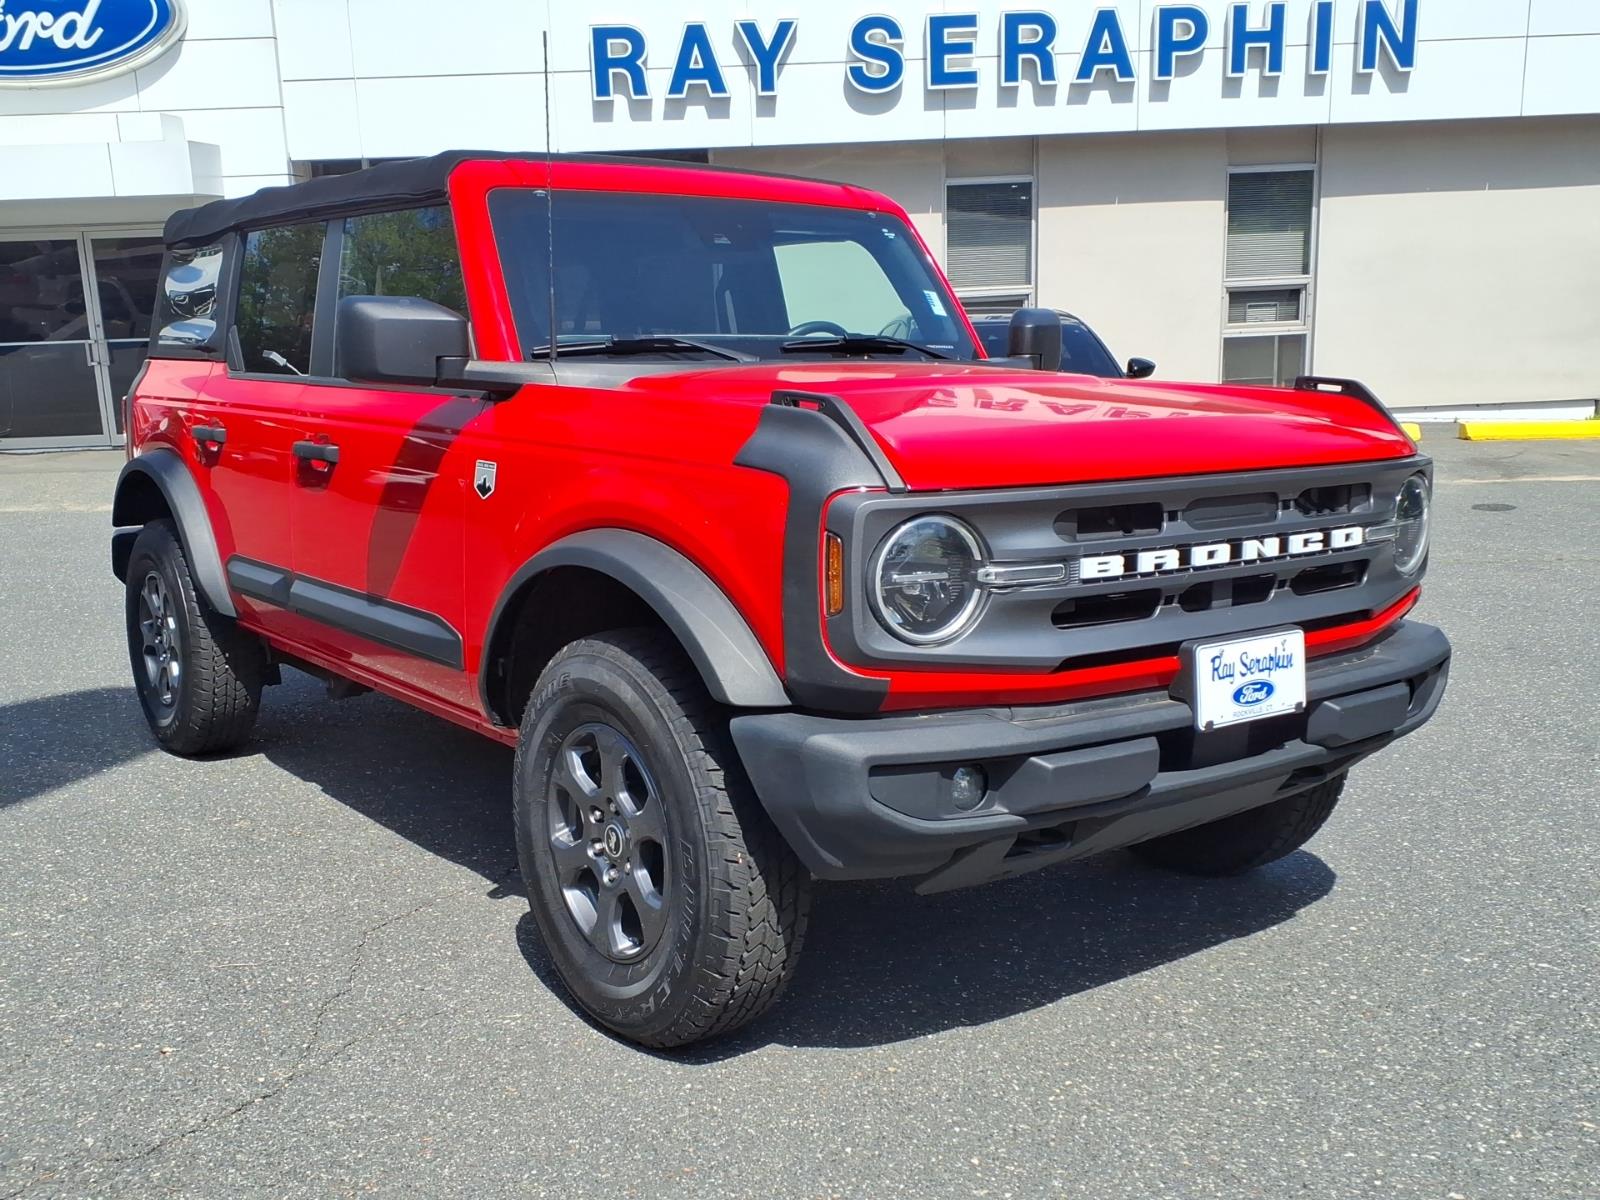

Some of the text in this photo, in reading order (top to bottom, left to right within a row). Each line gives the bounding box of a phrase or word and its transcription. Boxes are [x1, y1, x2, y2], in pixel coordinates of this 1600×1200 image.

[0, 0, 104, 51] ord
[589, 0, 1418, 101] RAY SERAPHIN
[1079, 526, 1363, 580] BRONCO
[1210, 639, 1293, 684] Ray Seraphin
[1239, 682, 1269, 703] Ford
